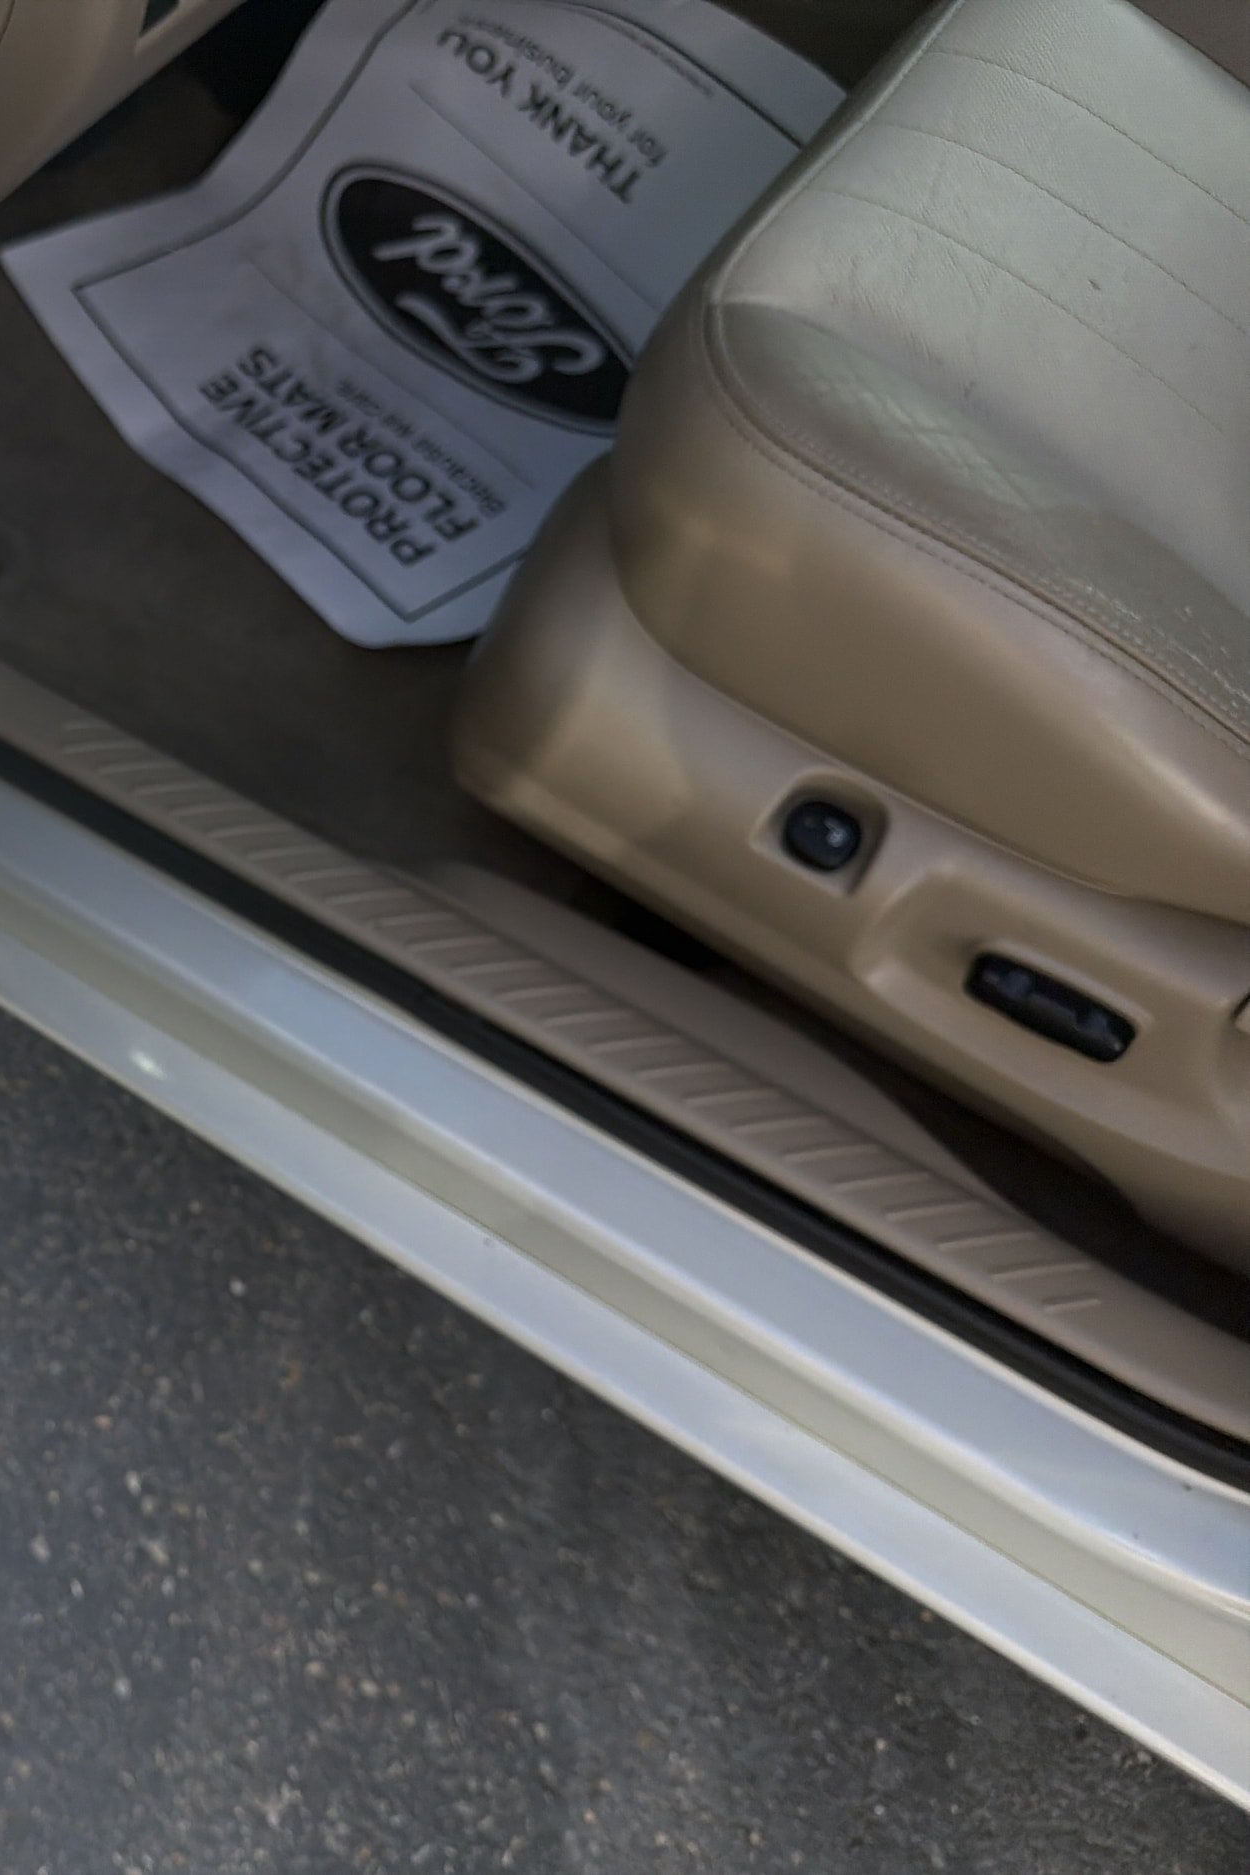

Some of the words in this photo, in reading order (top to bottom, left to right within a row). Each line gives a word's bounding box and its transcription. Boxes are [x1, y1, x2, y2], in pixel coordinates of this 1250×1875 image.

[437, 29, 516, 97] YOU
[574, 82, 633, 133] your
[519, 82, 642, 202] THANK
[629, 129, 668, 167] for
[374, 213, 607, 383] Ford
[240, 348, 347, 434] MATS
[200, 371, 436, 566] PROTECTIVE
[339, 427, 479, 541] FLOOR
